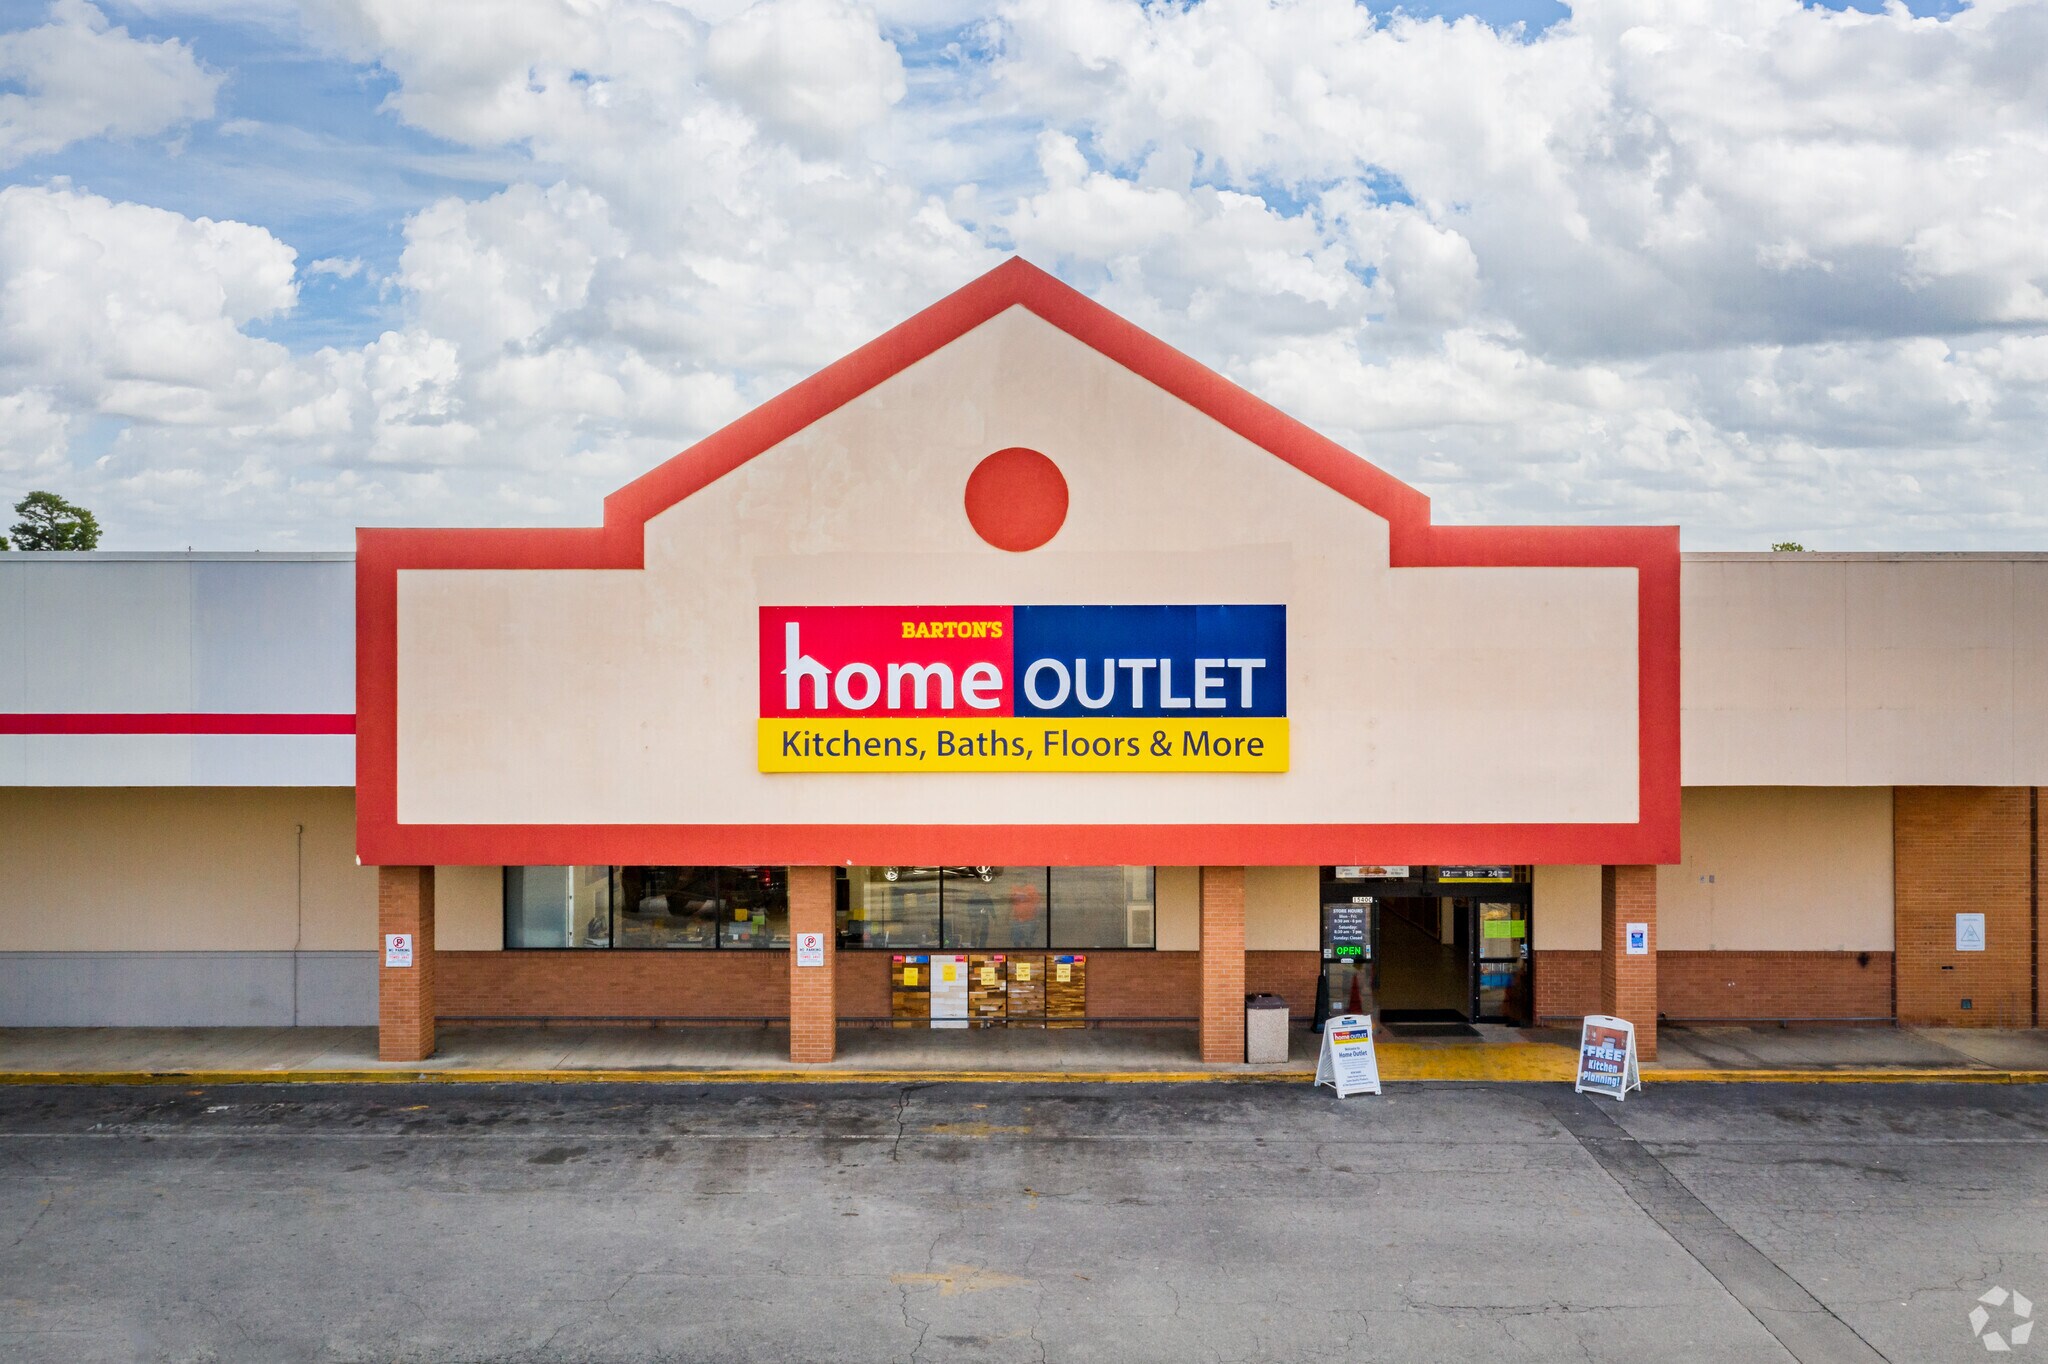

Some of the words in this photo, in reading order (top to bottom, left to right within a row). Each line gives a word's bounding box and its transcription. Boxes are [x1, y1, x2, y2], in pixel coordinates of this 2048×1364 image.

[901, 621, 1003, 639] BARTON'S
[780, 621, 1004, 710] home
[1023, 658, 1267, 710] OUTLET
[782, 729, 927, 761] Kitchens,
[937, 729, 1033, 761] Baths,
[1044, 729, 1140, 757] Floors
[1149, 730, 1173, 757] &
[1182, 730, 1265, 757] More
[1336, 946, 1361, 955] OPEN
[1587, 1045, 1622, 1062] FREE
[1588, 1060, 1618, 1073] Kitchen
[1583, 1071, 1620, 1087] Planning!
